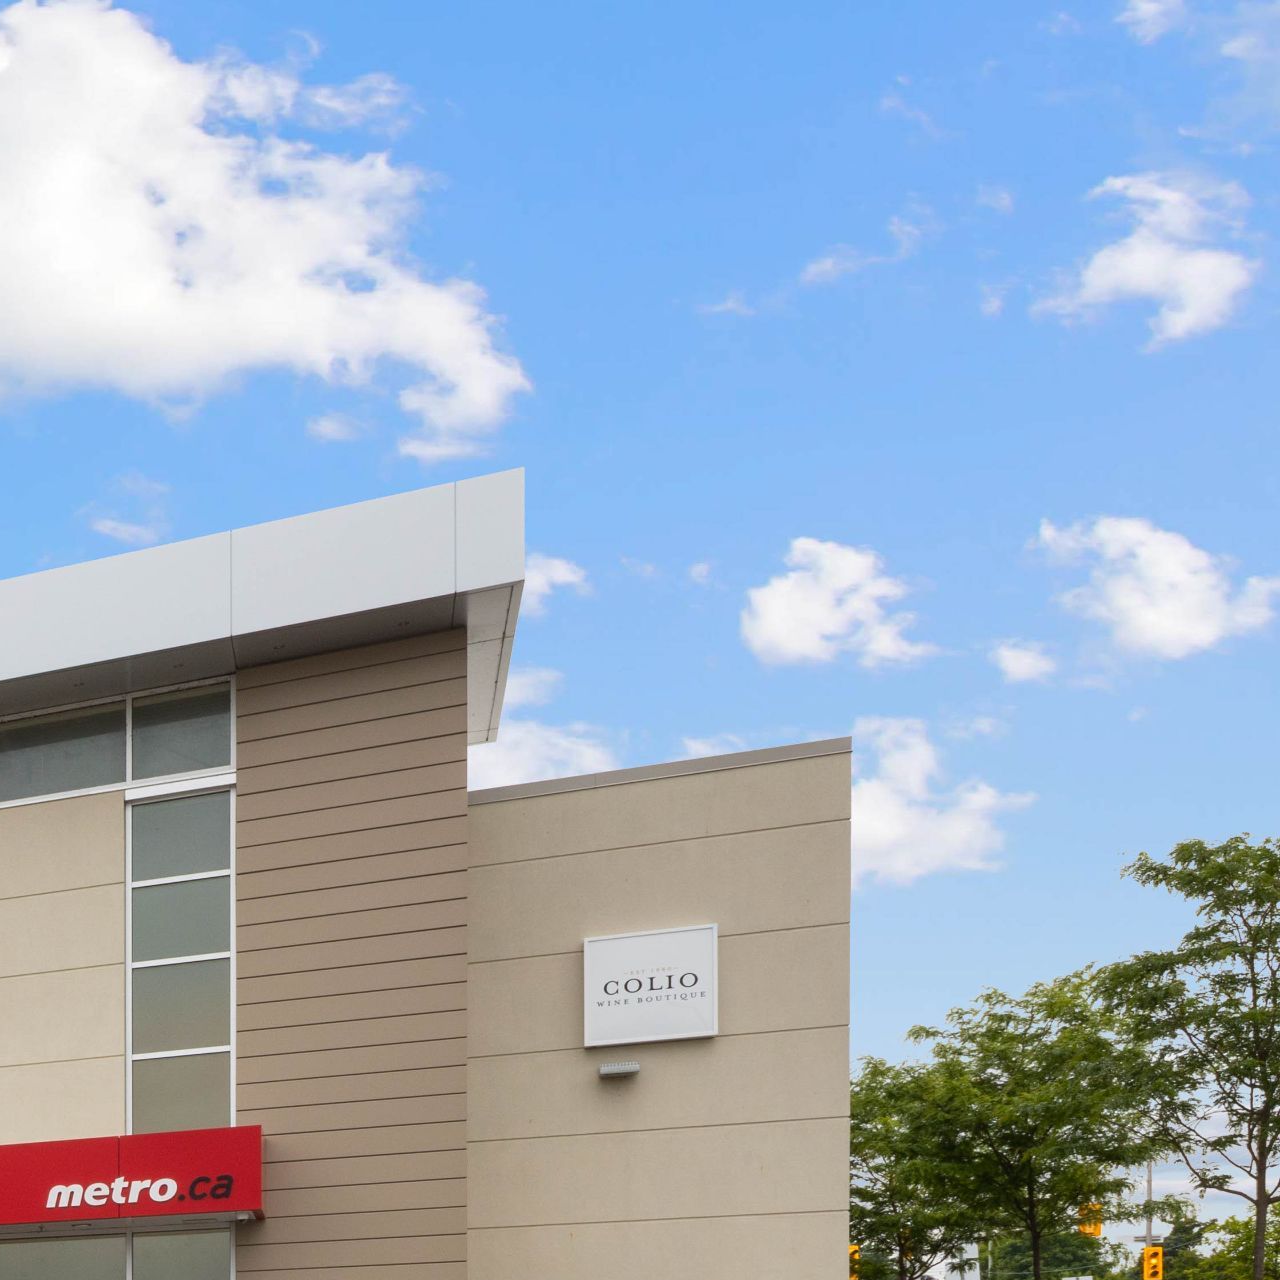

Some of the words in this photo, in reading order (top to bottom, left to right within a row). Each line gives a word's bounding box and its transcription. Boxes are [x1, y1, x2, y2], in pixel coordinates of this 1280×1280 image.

[603, 972, 698, 995] COLIO
[597, 998, 630, 1007] WINE
[637, 991, 707, 1004] BOUTIQUE
[46, 1174, 234, 1208] metro.ca
